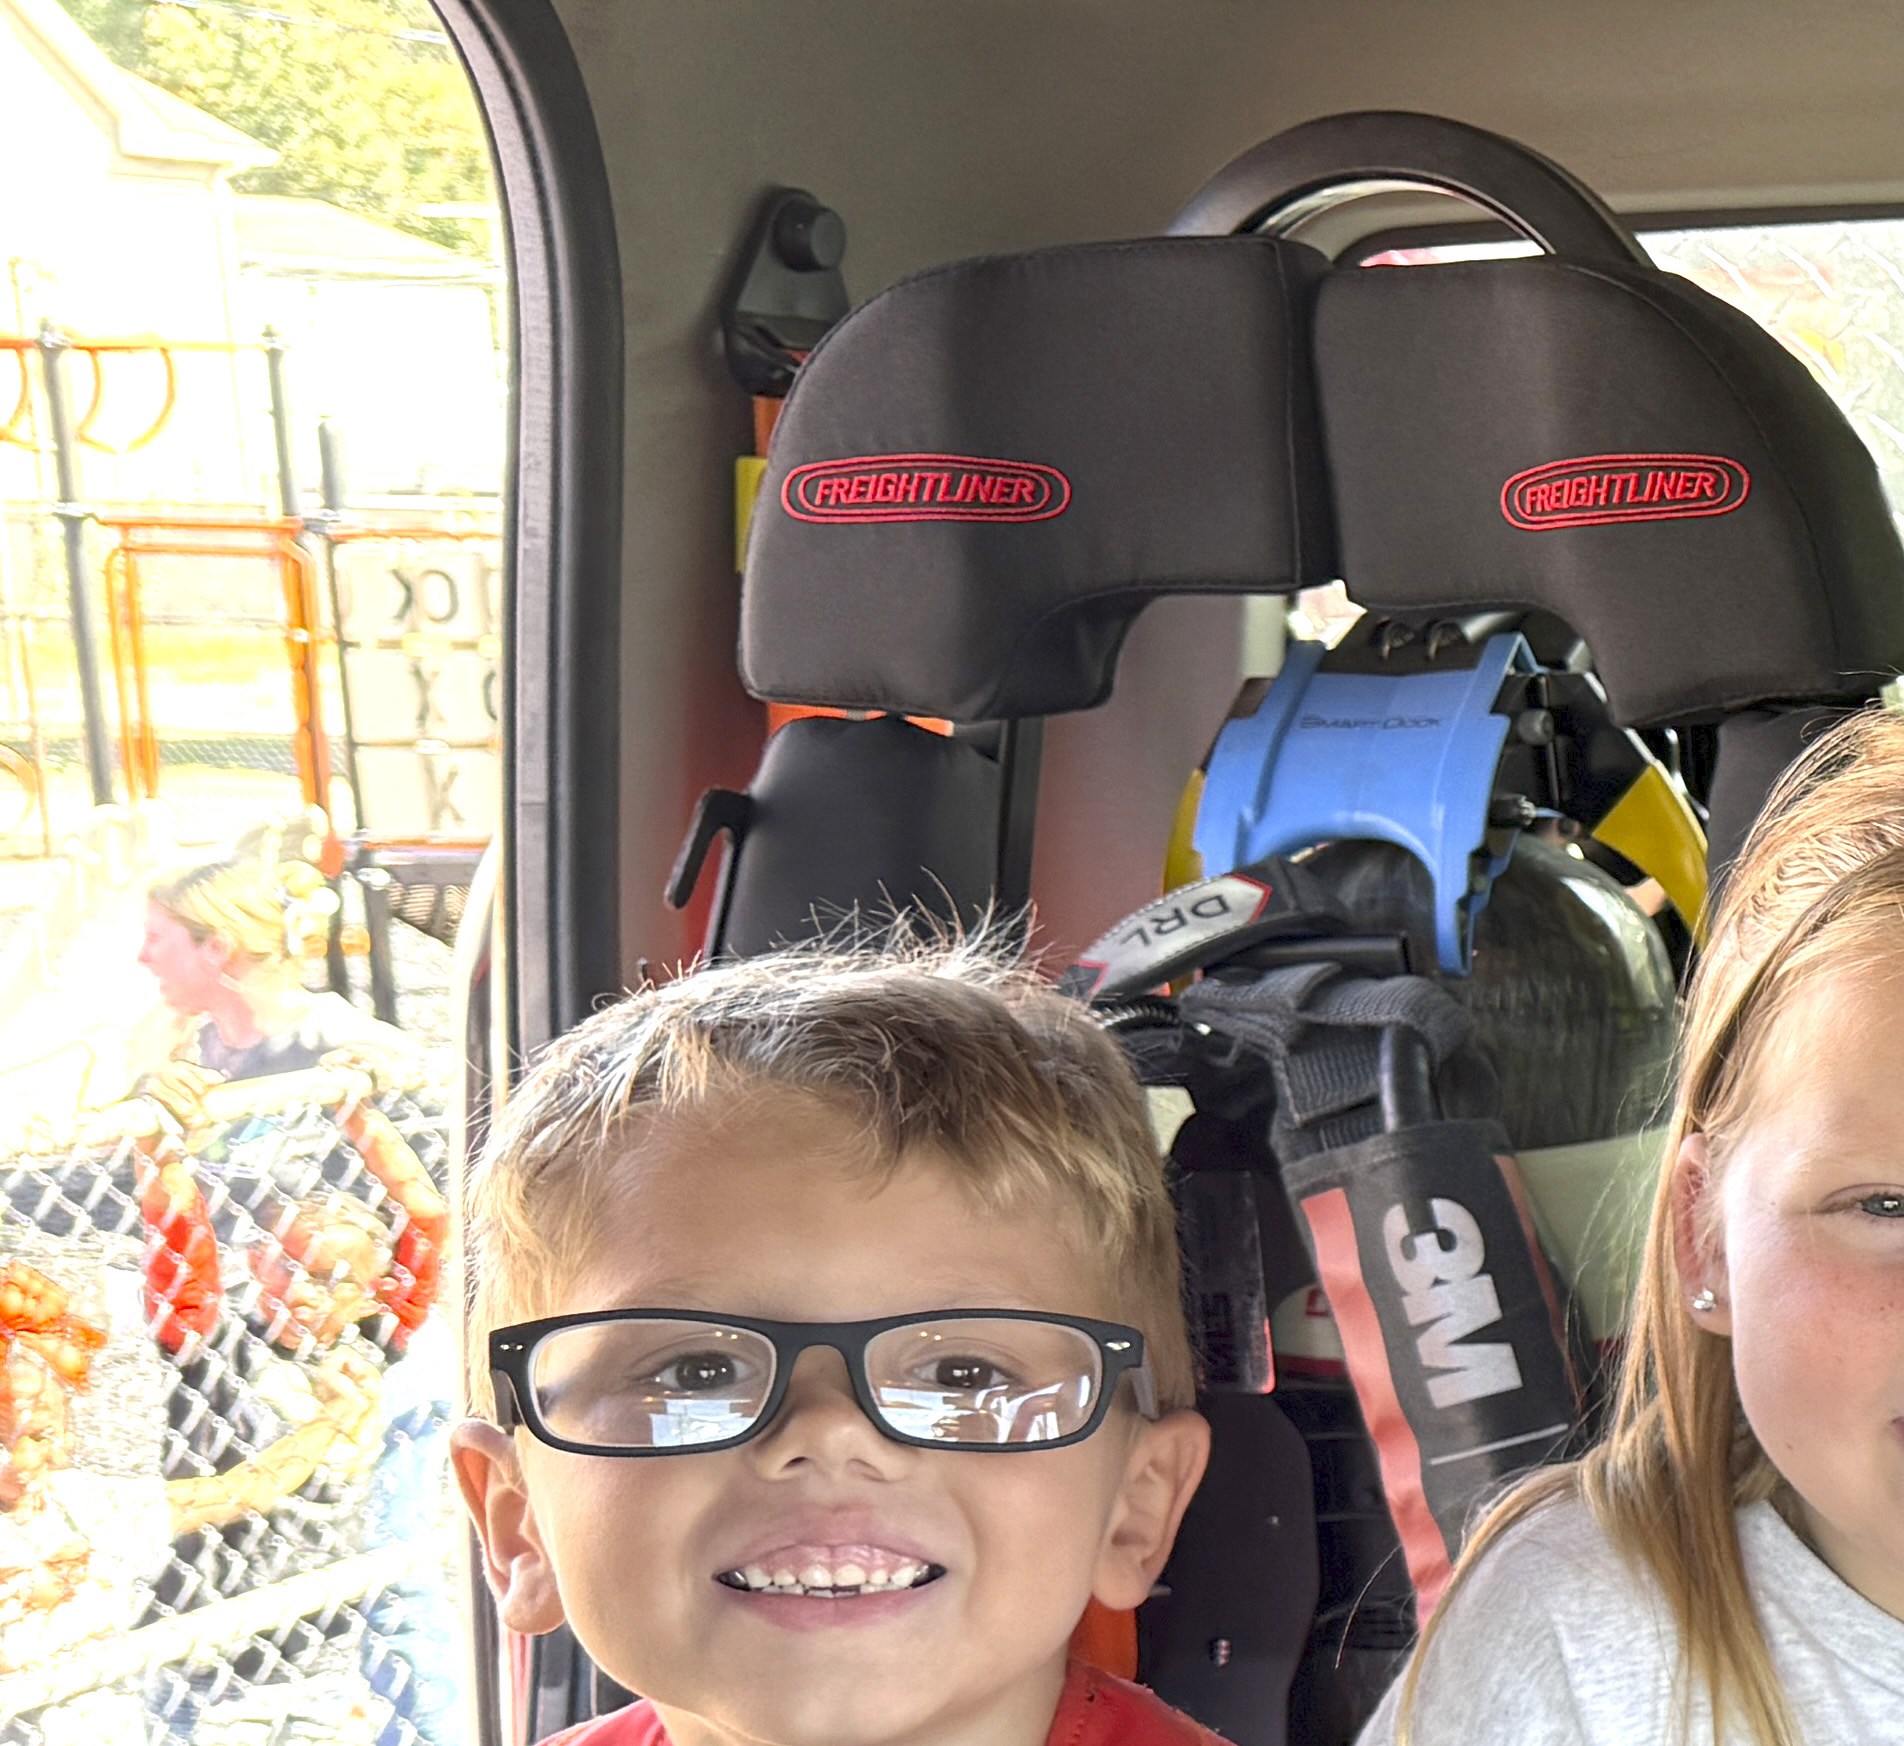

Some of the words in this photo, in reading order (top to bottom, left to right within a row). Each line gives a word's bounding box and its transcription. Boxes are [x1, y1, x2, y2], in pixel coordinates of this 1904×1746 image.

[814, 471, 1037, 506] FREIGHTLINER
[1525, 470, 1718, 516] FREIGHTLINER
[1382, 1196, 1524, 1411] 3M
